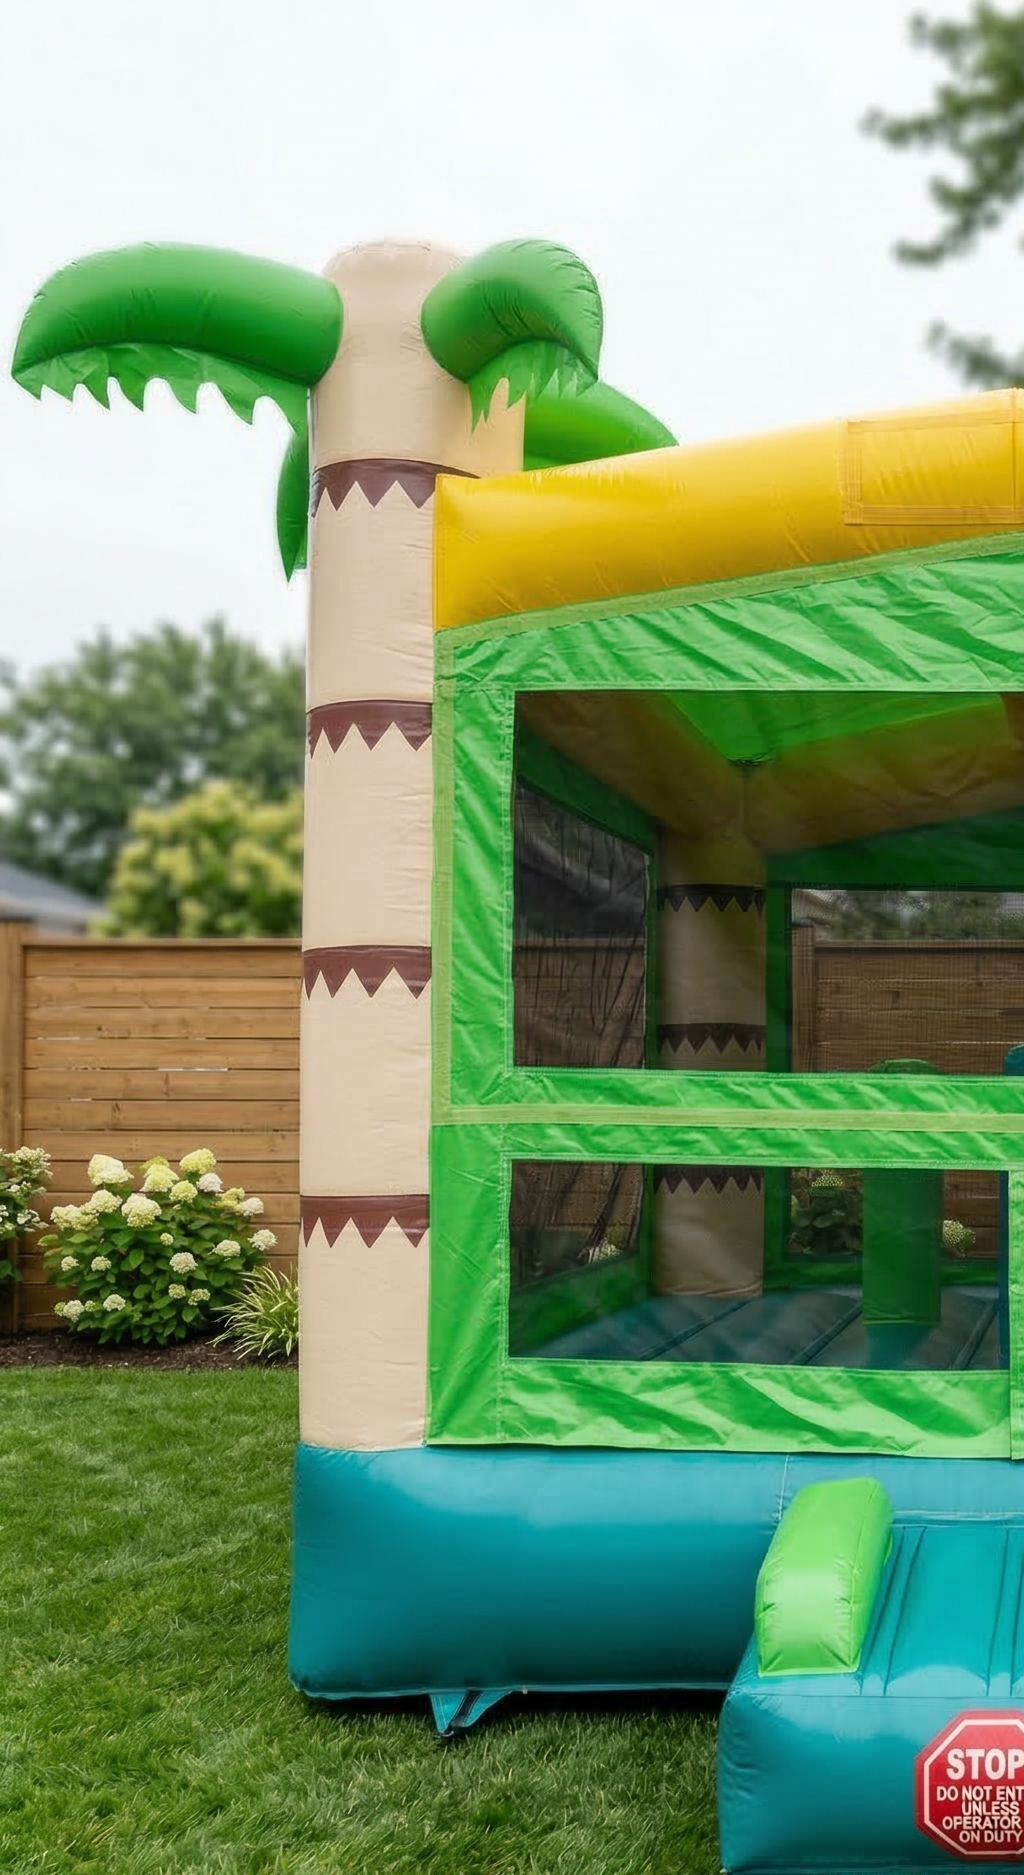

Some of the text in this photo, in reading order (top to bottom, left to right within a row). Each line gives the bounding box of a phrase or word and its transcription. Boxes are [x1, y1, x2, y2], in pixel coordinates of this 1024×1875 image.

[936, 1785, 958, 1801] DO
[961, 1785, 992, 1801] NOT
[961, 1801, 1020, 1816] UNLESS
[942, 1815, 1022, 1830] OPERATOR
[959, 1830, 1023, 1843] ON DUTY
